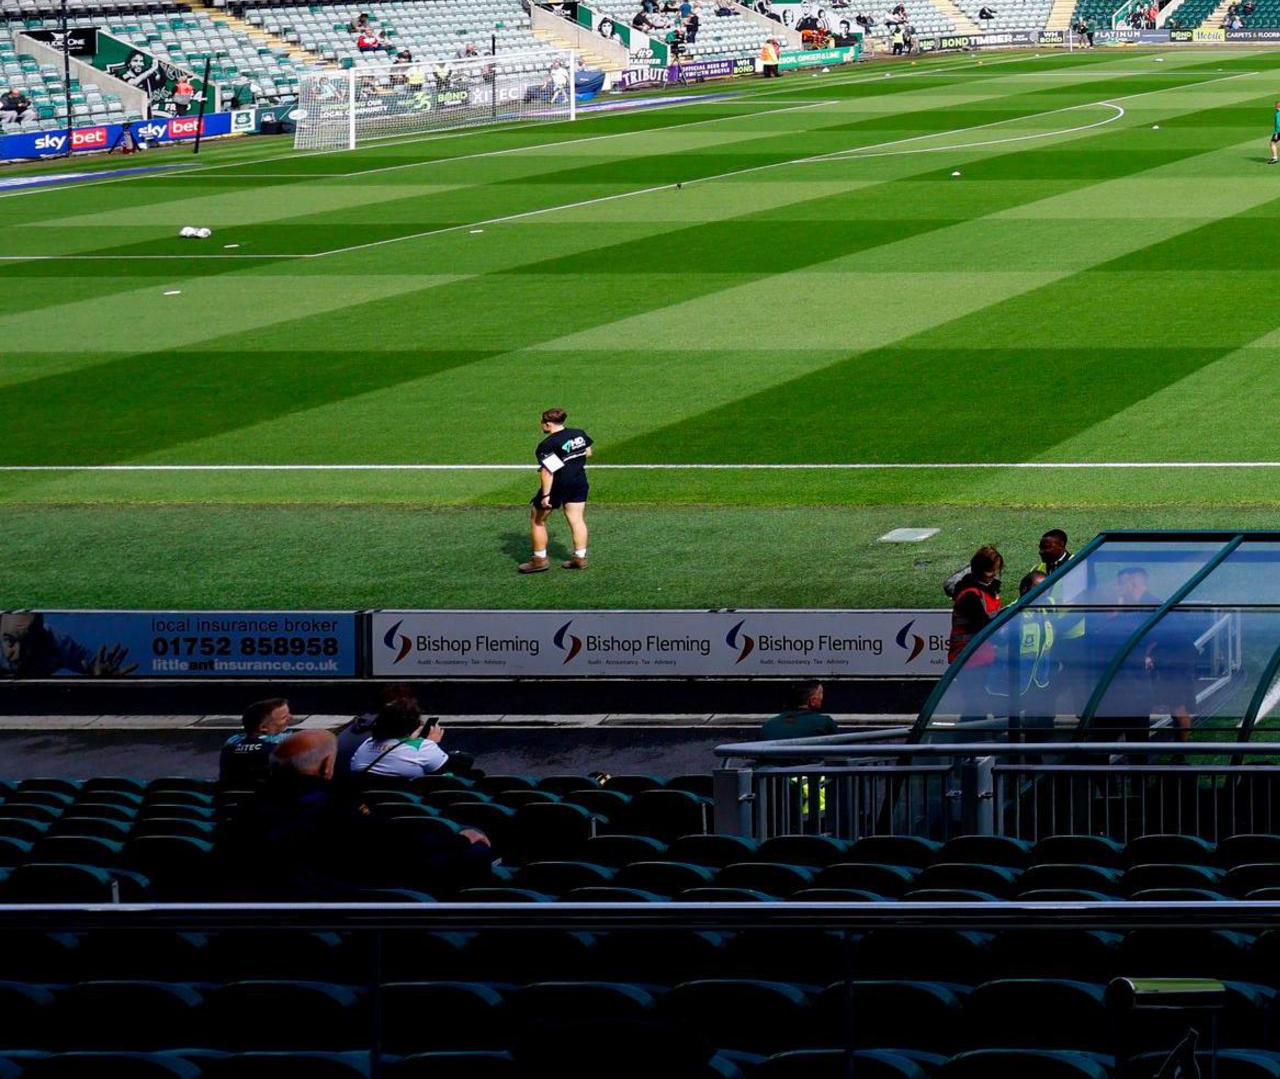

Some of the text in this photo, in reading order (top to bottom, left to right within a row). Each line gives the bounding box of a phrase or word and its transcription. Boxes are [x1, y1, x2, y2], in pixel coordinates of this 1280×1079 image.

[941, 34, 1013, 48] BOND TIMBER
[733, 65, 754, 75] BOND
[736, 59, 750, 67] WH
[622, 67, 669, 87] TRIBUTE
[437, 91, 468, 103] BOND
[138, 119, 199, 139] sky bet
[35, 130, 105, 154] sky bet
[151, 616, 338, 632] local insurance broker
[152, 637, 339, 656] 01752 858958
[416, 635, 540, 657] Bishop Fleming
[587, 635, 711, 657] Bishop Fleming
[759, 635, 882, 657] Bishop Fleming
[152, 657, 339, 672] littleantinsurance.co.uk
